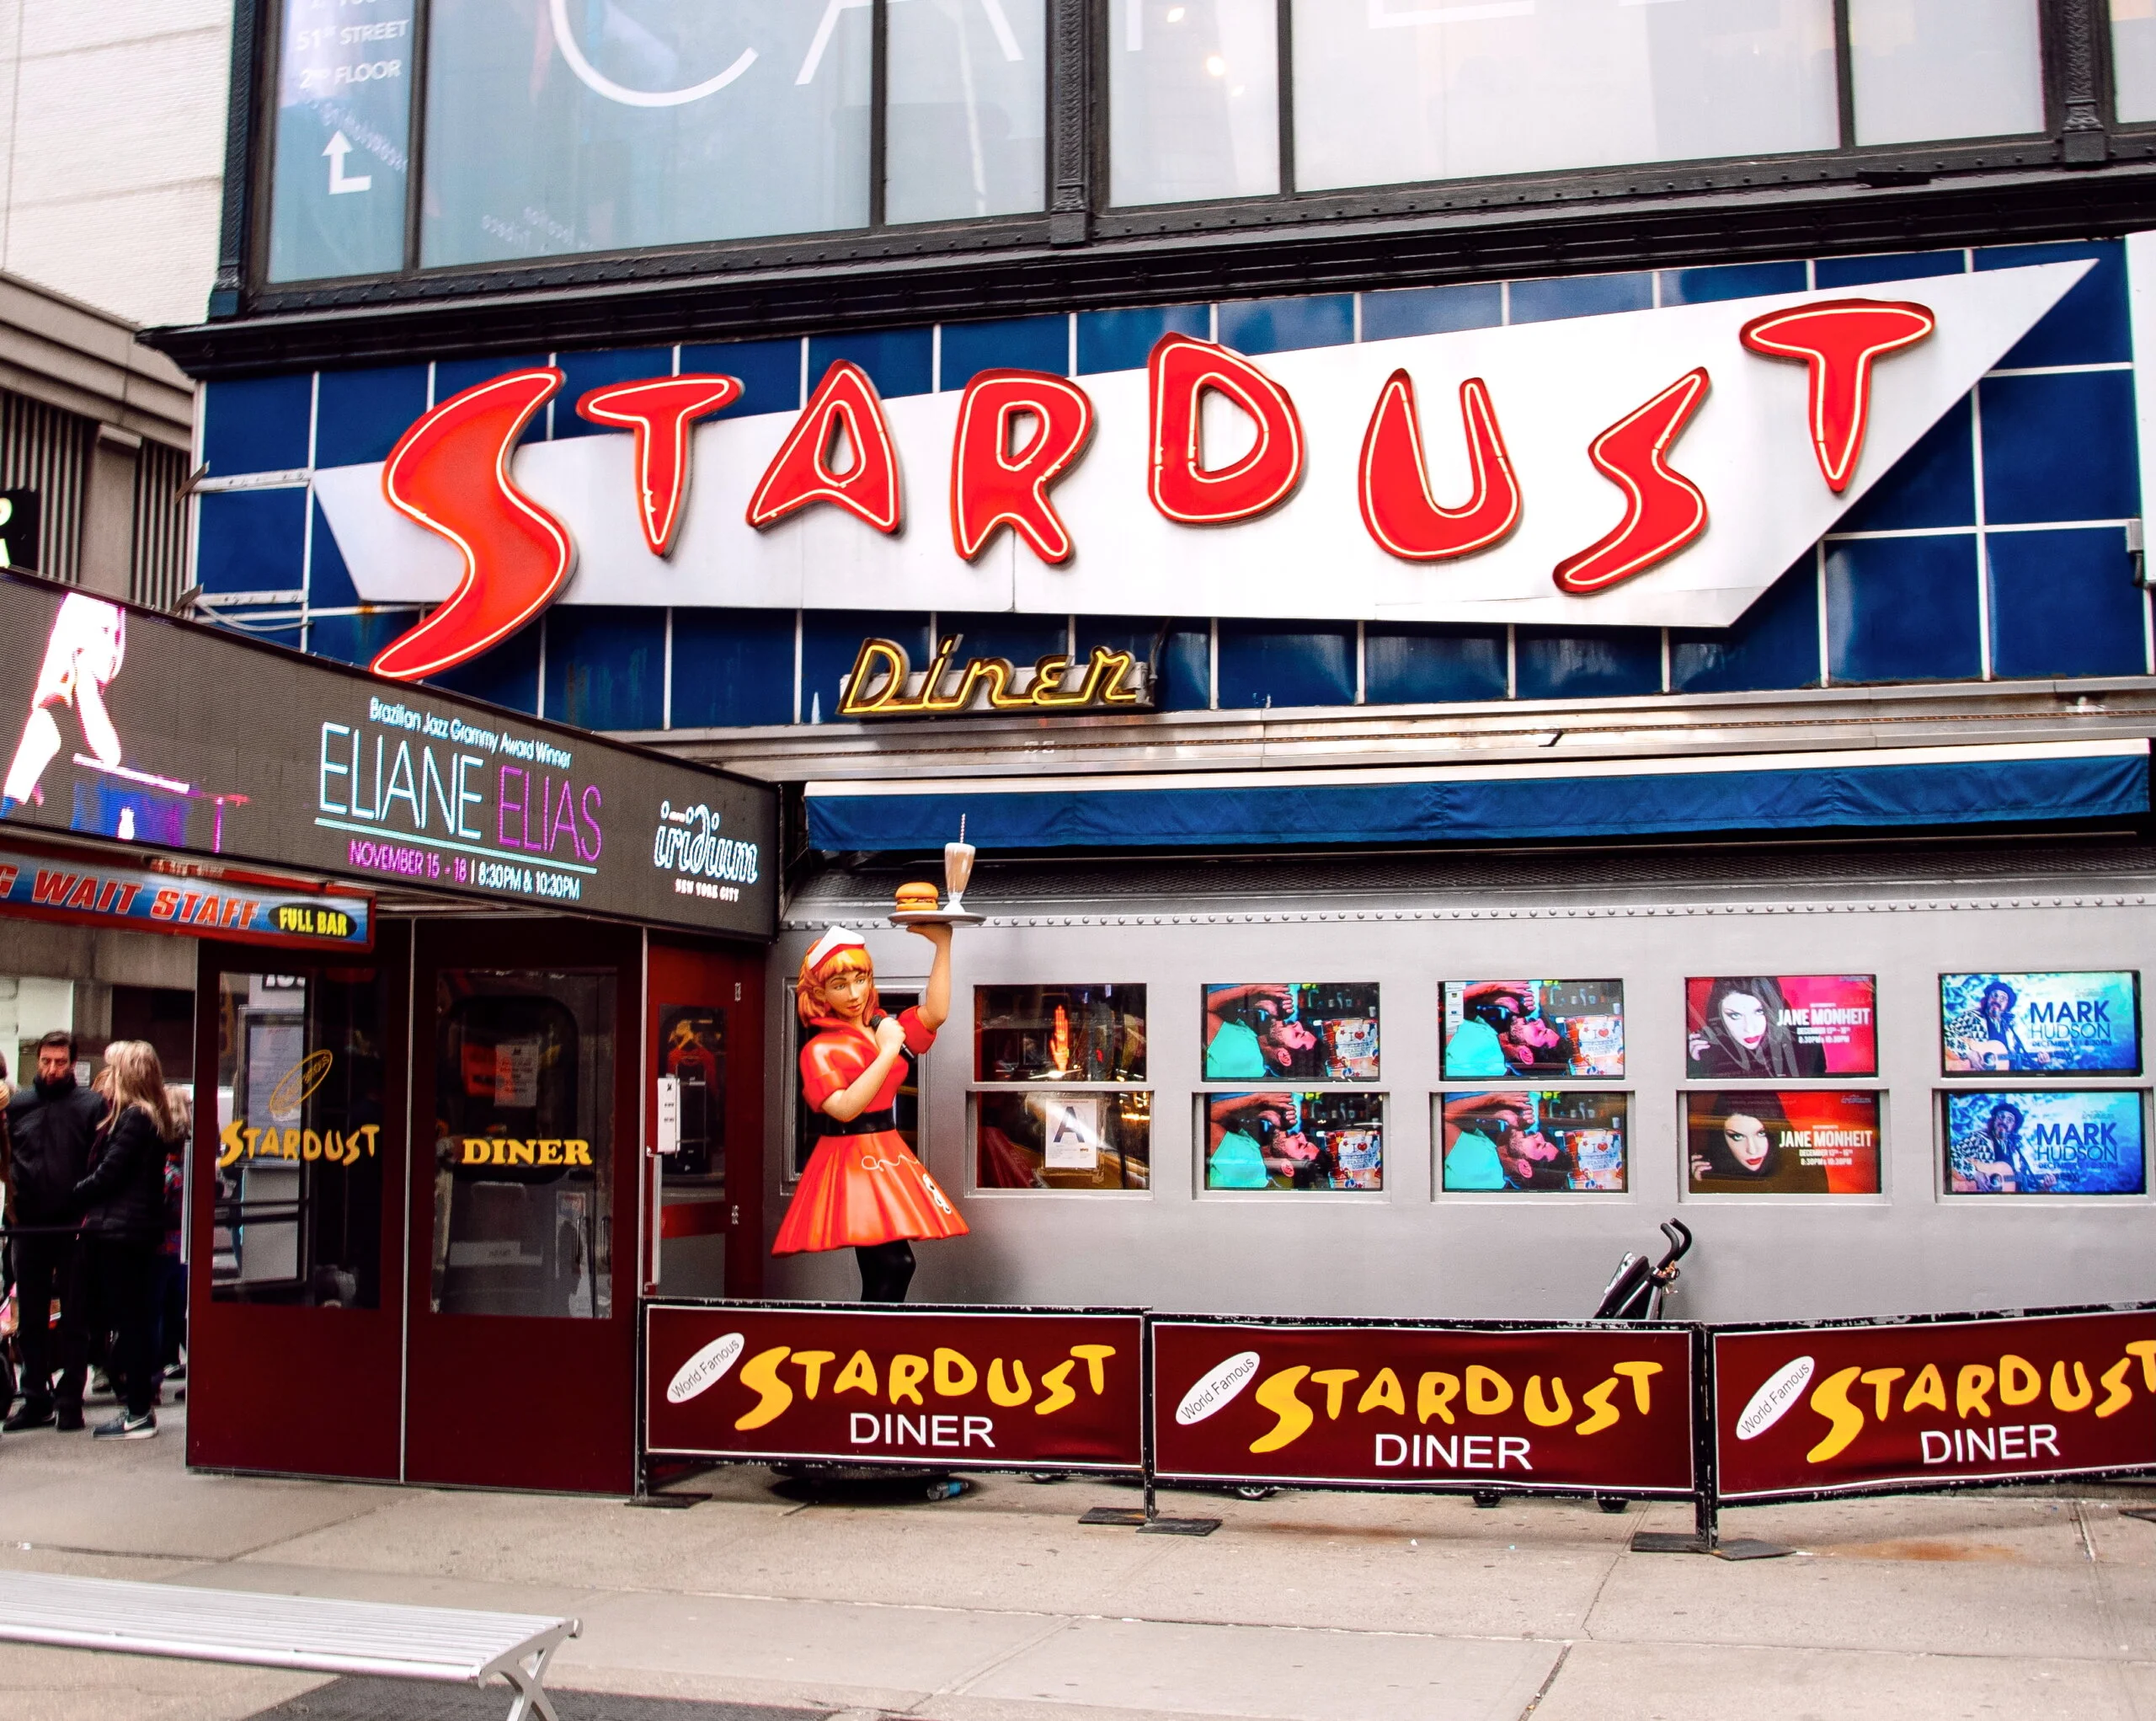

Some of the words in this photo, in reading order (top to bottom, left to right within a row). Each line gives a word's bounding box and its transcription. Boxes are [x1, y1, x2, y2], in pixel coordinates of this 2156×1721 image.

[340, 19, 409, 45] STREET
[334, 59, 402, 85] FLOOR
[370, 297, 1935, 679] STARDUST
[370, 696, 421, 731] Brazilian
[423, 712, 449, 740] Jazz
[450, 718, 499, 755] Grammy
[499, 732, 535, 760] Award
[536, 741, 573, 769] Winner
[319, 722, 484, 840] ELIANE
[498, 764, 602, 863] ELIAS
[348, 839, 424, 876] NOVEMBER
[426, 852, 440, 879] 15
[478, 861, 521, 893] 8:30PM
[523, 869, 532, 894] &
[535, 870, 580, 901] 10:30PM
[32, 869, 143, 913] WAIT
[150, 887, 260, 930] STAFF
[675, 879, 695, 895] NEW
[696, 881, 718, 899] YORK
[720, 886, 739, 902] CITY
[279, 907, 312, 934] FULL
[317, 911, 348, 937] BAR
[1777, 1008, 1810, 1026] JANE
[1812, 1007, 1870, 1026] MONHEIT
[2031, 1000, 2111, 1023] MARK
[2031, 1023, 2111, 1040] HUDSON
[1053, 1106, 1086, 1142] A
[1779, 1130, 1812, 1148] JANE
[1814, 1130, 1873, 1147] MONHEIT
[2036, 1122, 2117, 1146] MARK
[219, 1119, 380, 1168] STARDUST
[462, 1138, 592, 1167] DINER
[2036, 1145, 2118, 1162] HUDSON
[671, 1370, 702, 1398] World
[700, 1339, 739, 1375] Famous
[734, 1344, 1117, 1431] STARDUST
[1181, 1389, 1214, 1419] World
[1211, 1358, 1255, 1395] Famous
[1741, 1399, 1772, 1434] World
[1769, 1364, 1810, 1405] Famous
[1806, 1339, 2156, 1464] STARDUST
[1249, 1360, 1663, 1453] STARDUST
[851, 1412, 995, 1448] DINER
[1921, 1424, 2061, 1464] DINER
[1375, 1434, 1534, 1470] DINER
